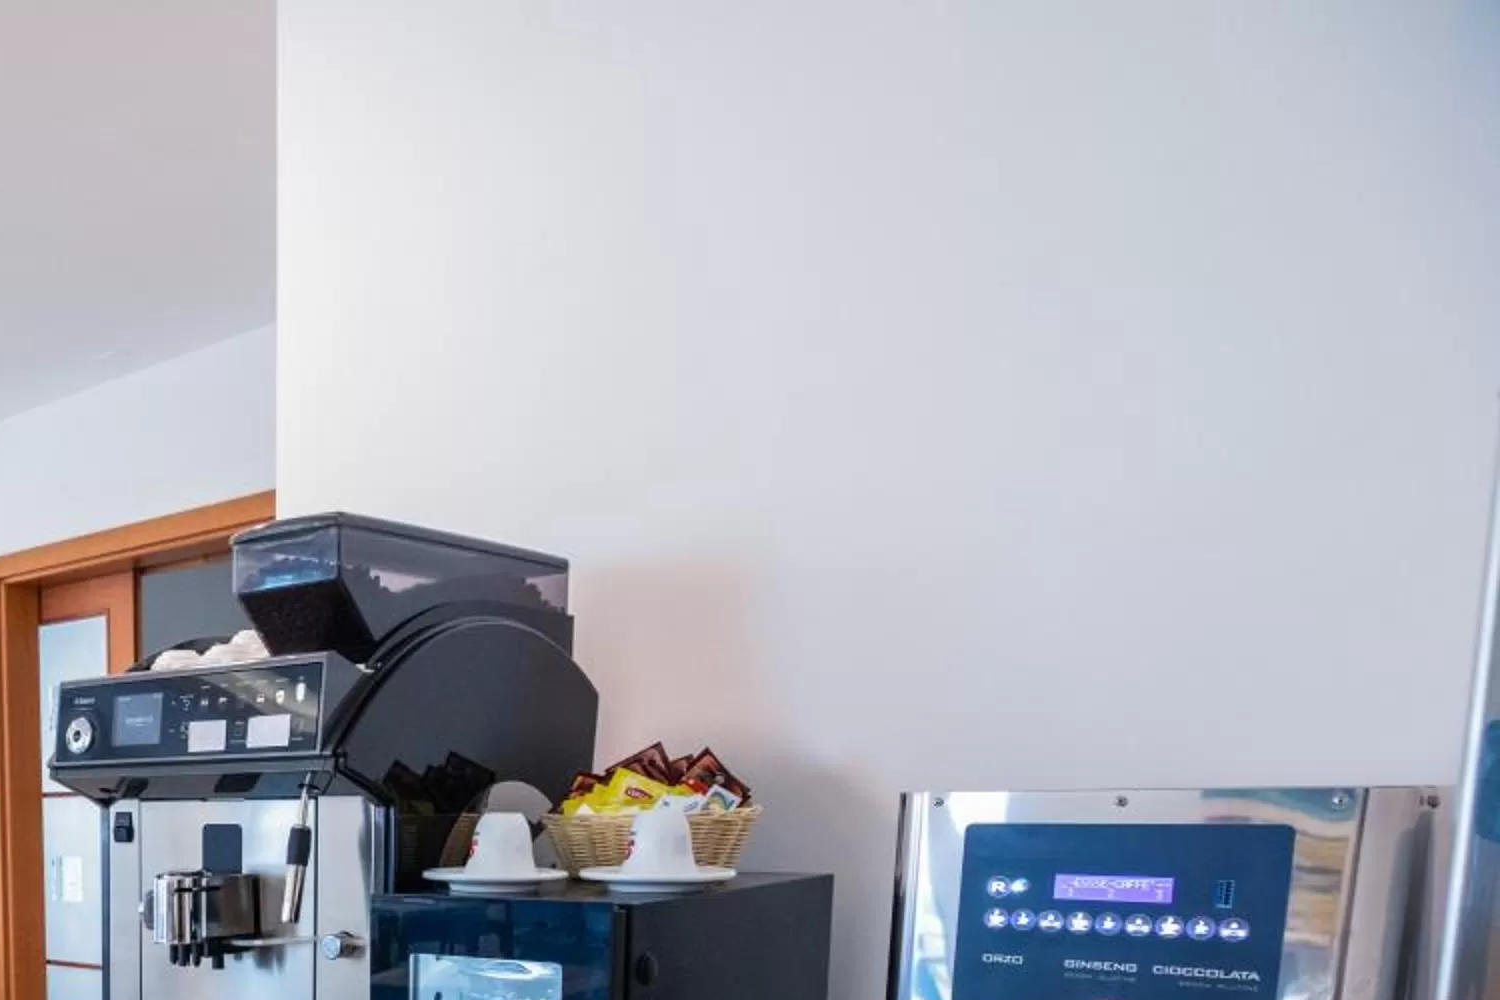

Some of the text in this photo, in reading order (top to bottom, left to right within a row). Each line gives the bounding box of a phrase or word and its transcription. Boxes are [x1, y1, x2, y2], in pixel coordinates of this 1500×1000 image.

[981, 953, 1024, 966] ORZO
[1063, 958, 1139, 973] GINSENG
[1152, 964, 1261, 982] CIOCCOLATA
